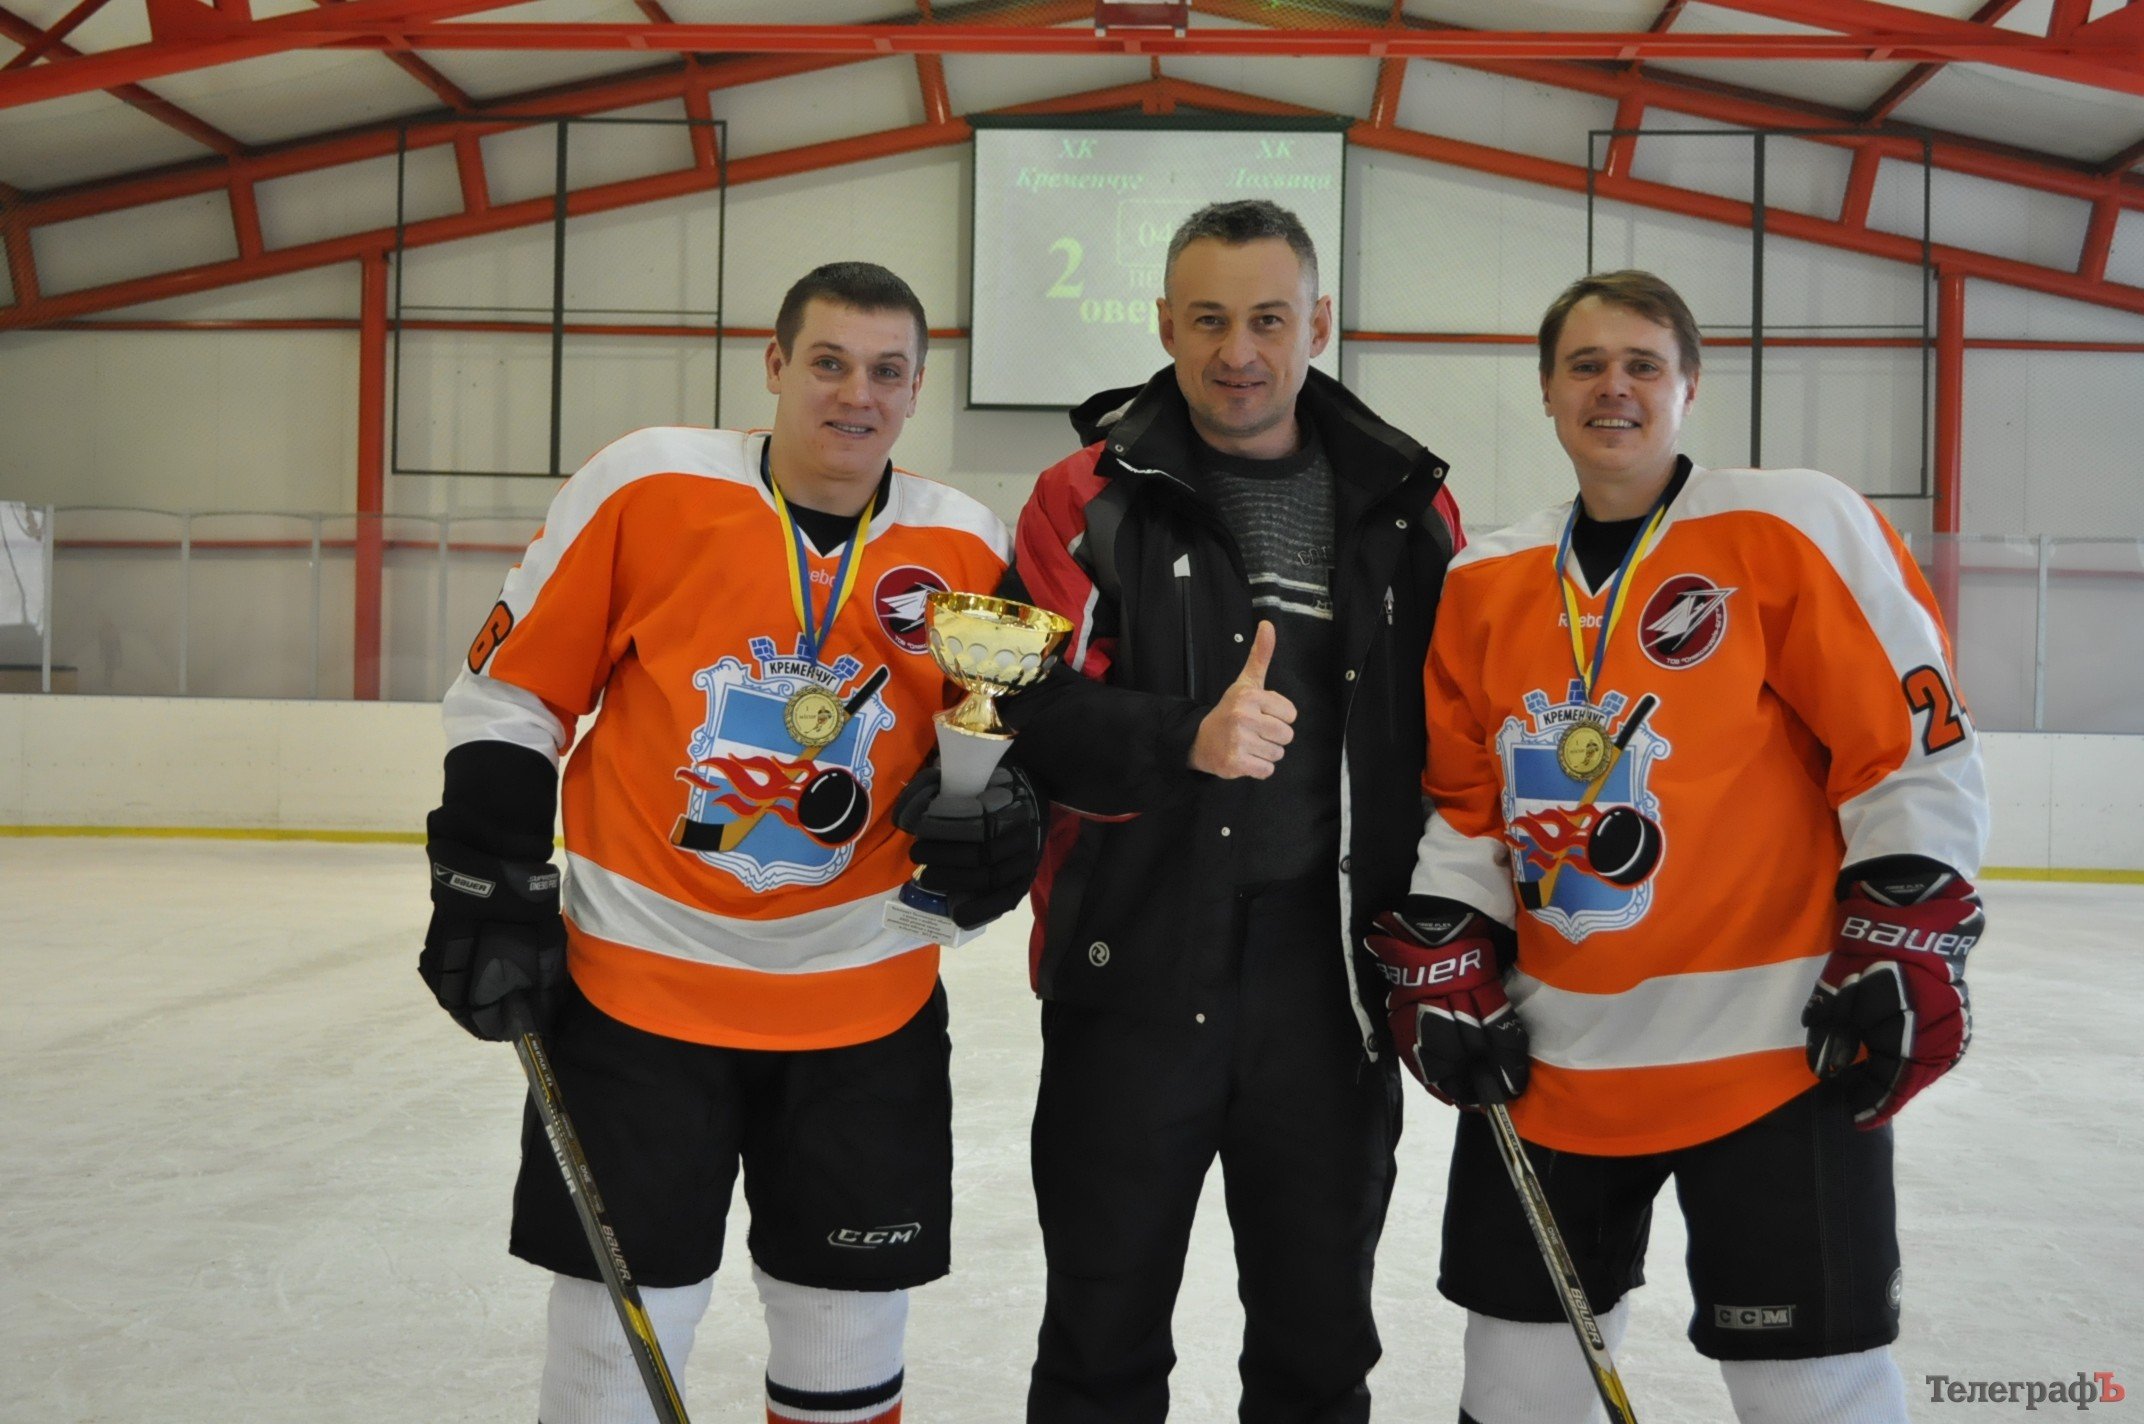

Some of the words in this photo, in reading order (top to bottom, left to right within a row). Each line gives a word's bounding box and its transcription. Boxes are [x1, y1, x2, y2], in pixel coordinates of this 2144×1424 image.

[1046, 237, 1086, 299] 2
[1080, 300, 1159, 334] овер
[769, 661, 838, 686] КРЕМЕНЧУГ
[837, 1228, 914, 1244] CCM
[1570, 1286, 1602, 1345] BAUER
[1717, 1307, 1790, 1326] CCM
